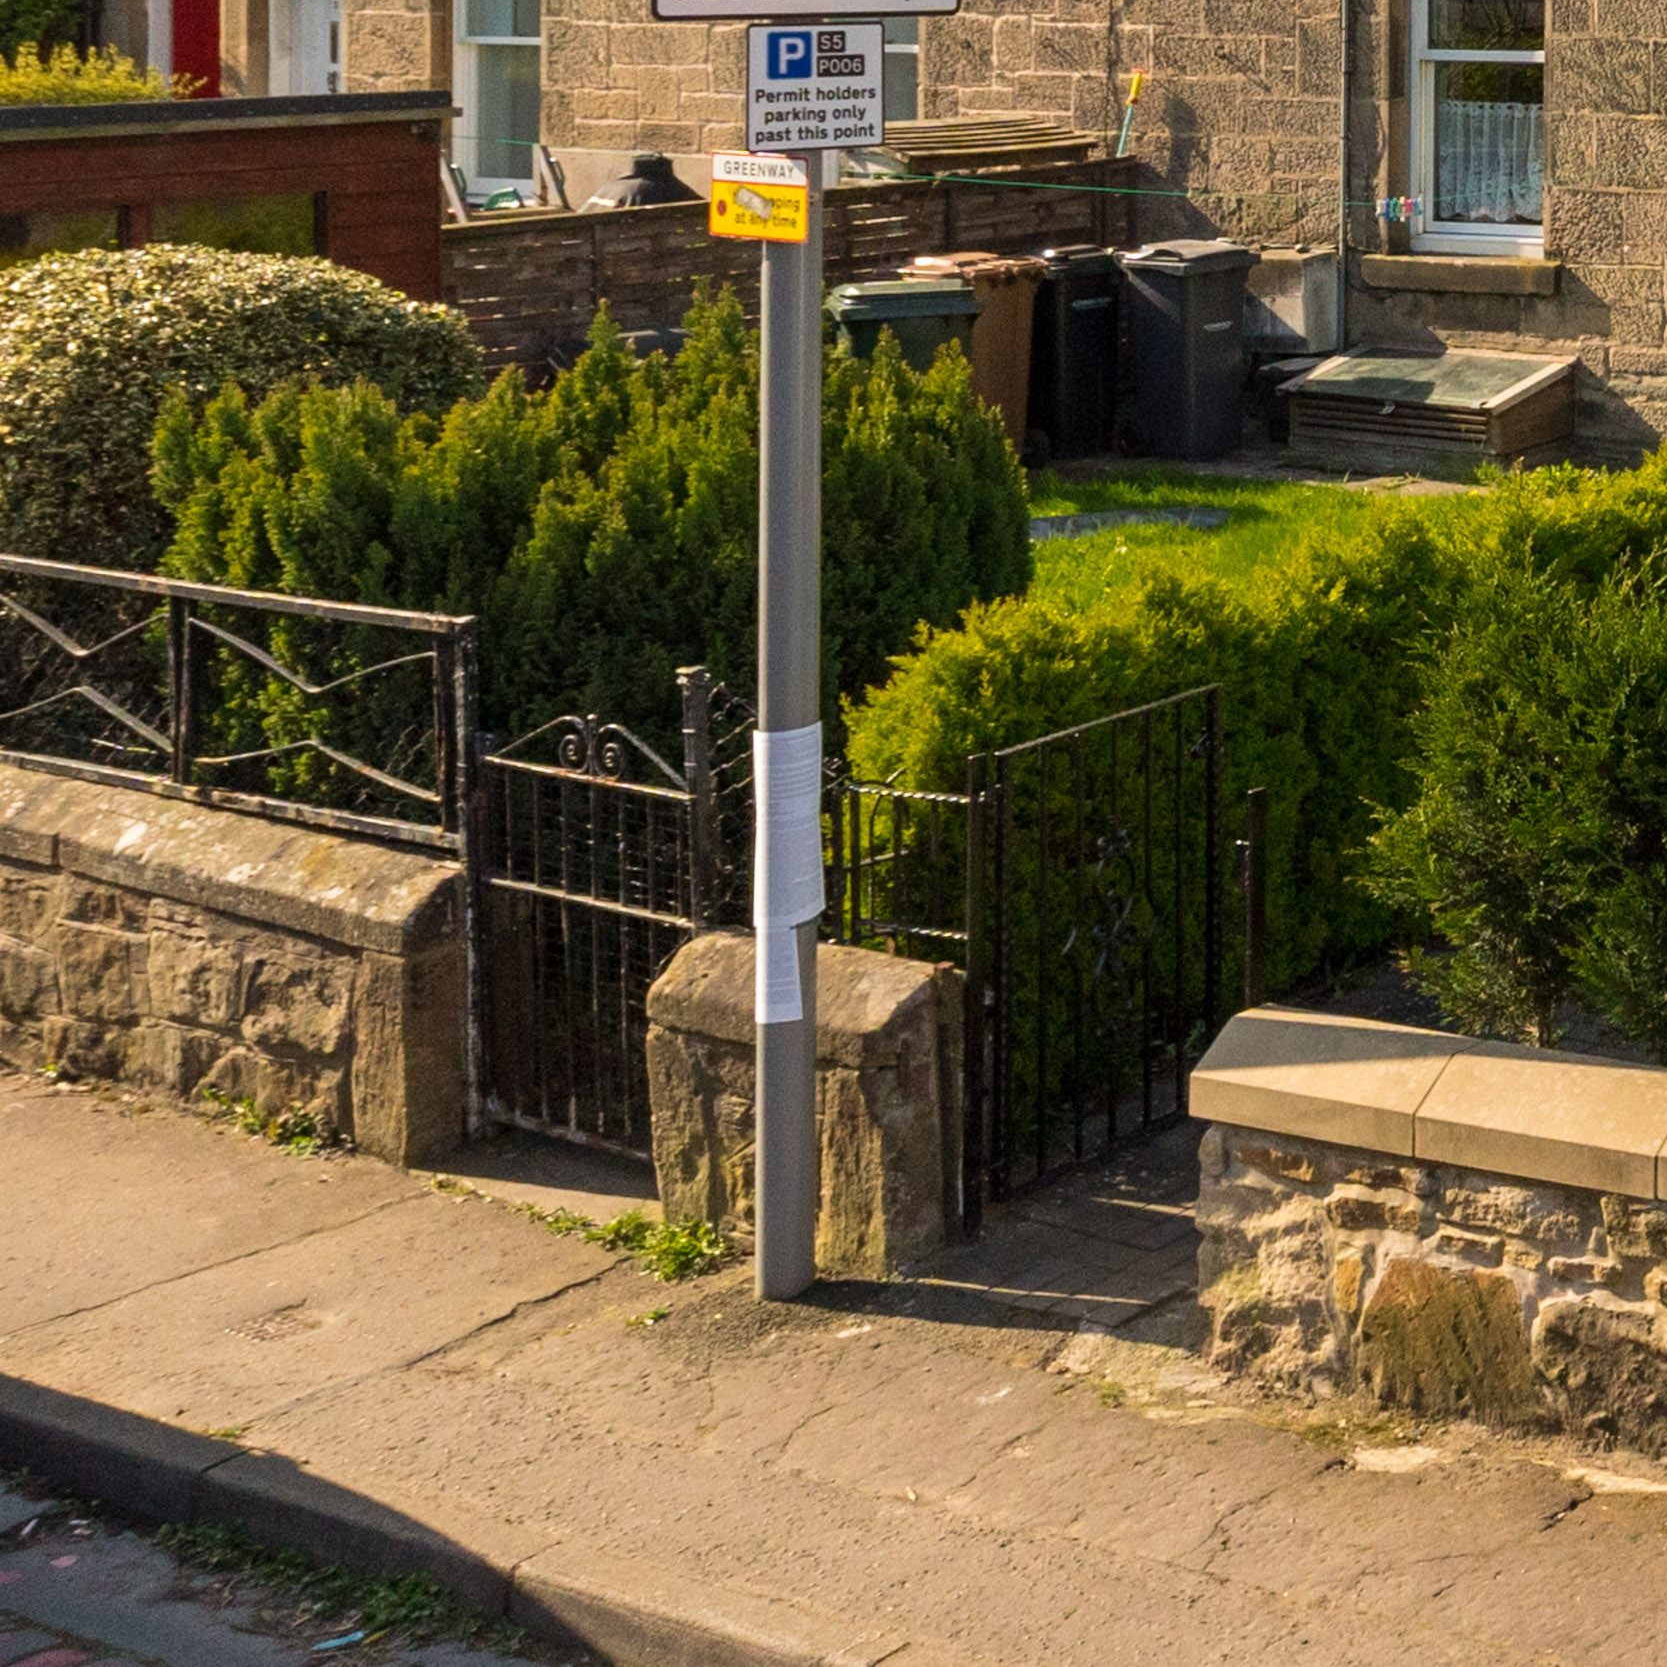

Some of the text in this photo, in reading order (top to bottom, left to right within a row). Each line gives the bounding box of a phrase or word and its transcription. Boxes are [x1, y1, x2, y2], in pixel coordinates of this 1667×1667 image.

[820, 34, 843, 50] S5
[778, 37, 805, 75] P
[819, 58, 863, 74] P006
[755, 85, 877, 103] Permit holders
[764, 104, 867, 125] parking only
[755, 122, 875, 145] past this point
[724, 161, 795, 178] GREENWAY
[734, 212, 746, 225] at
[772, 213, 798, 228] time
